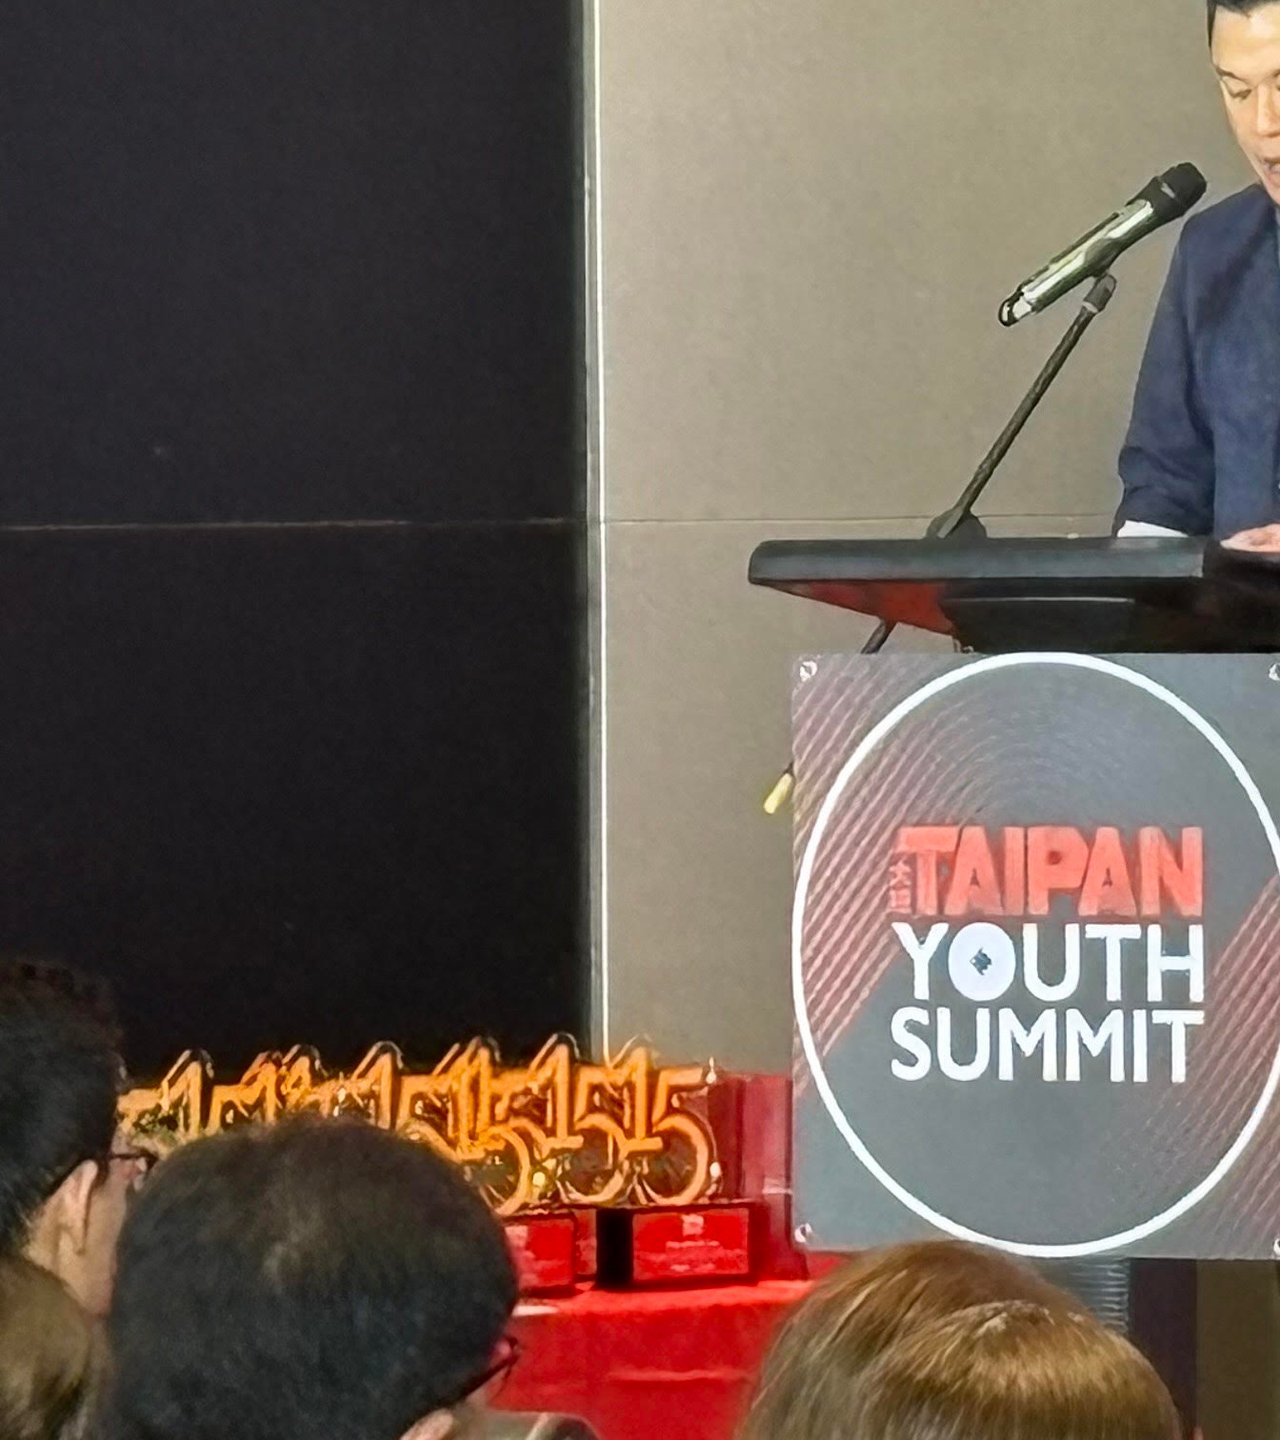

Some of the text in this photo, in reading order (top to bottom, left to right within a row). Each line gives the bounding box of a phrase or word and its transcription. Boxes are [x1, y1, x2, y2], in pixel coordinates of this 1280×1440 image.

[898, 825, 1204, 917] TAIPAN
[890, 922, 1204, 1003] YOUTH
[889, 1007, 1205, 1083] SUMMIT
